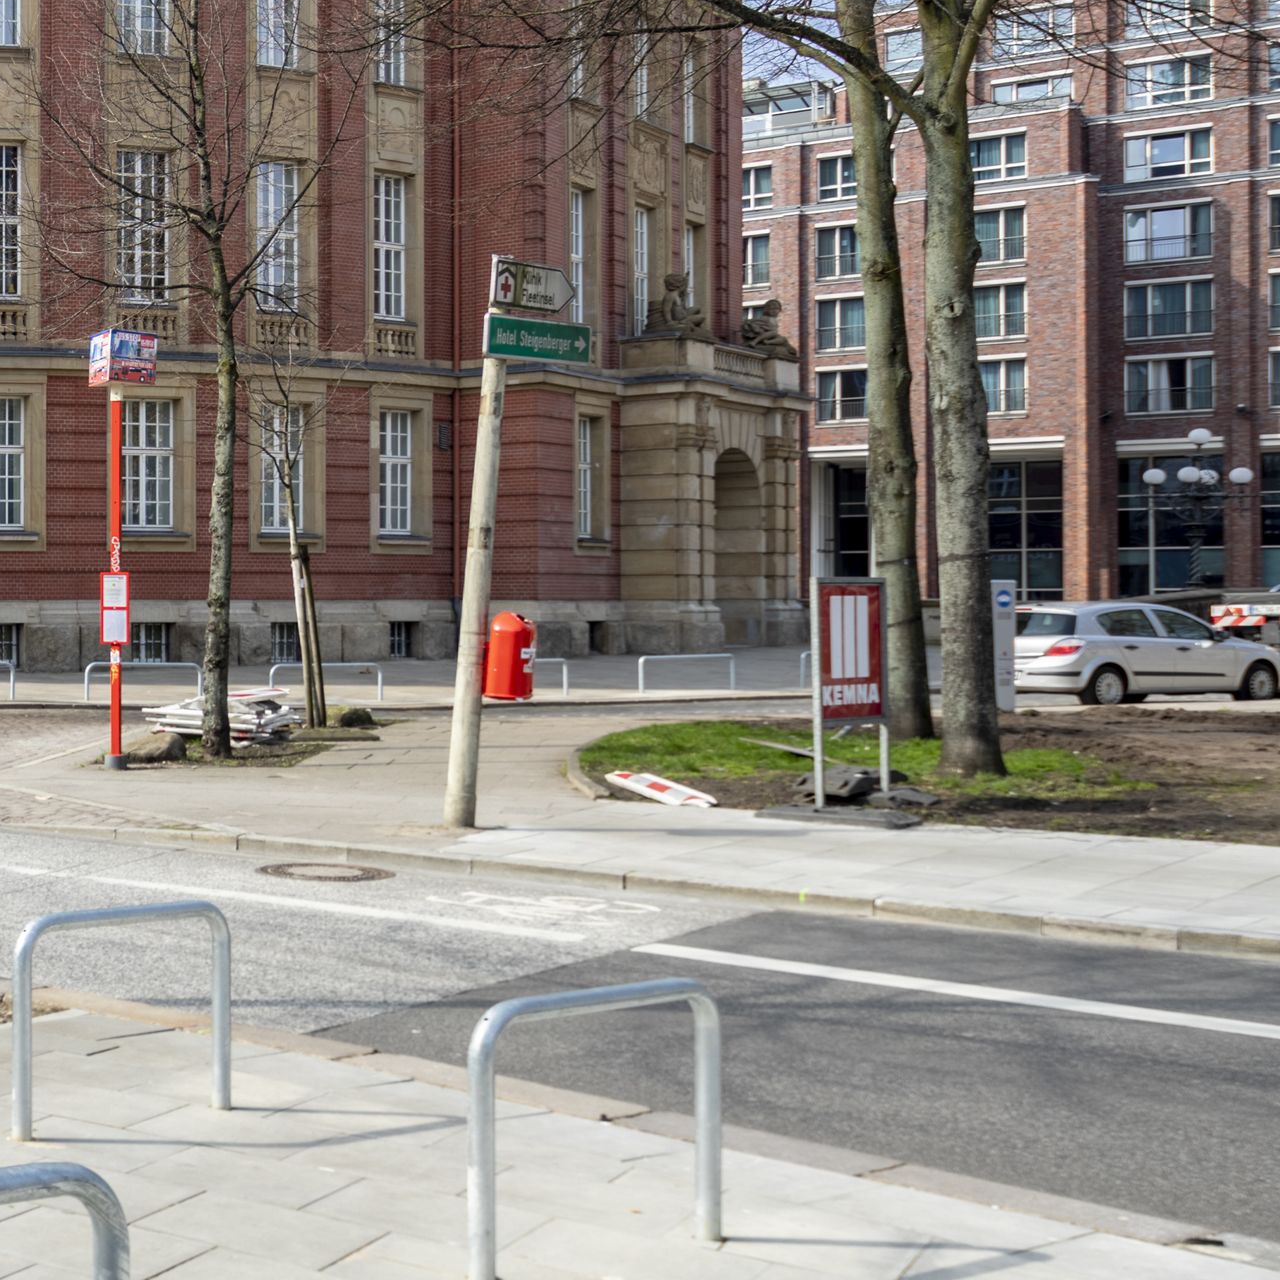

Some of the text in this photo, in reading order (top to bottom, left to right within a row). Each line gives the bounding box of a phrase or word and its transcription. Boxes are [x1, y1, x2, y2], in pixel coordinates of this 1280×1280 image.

[522, 288, 555, 306] Fleetinsel
[496, 328, 572, 354] Hotel Steigenberger
[822, 683, 880, 706] KEMNA
